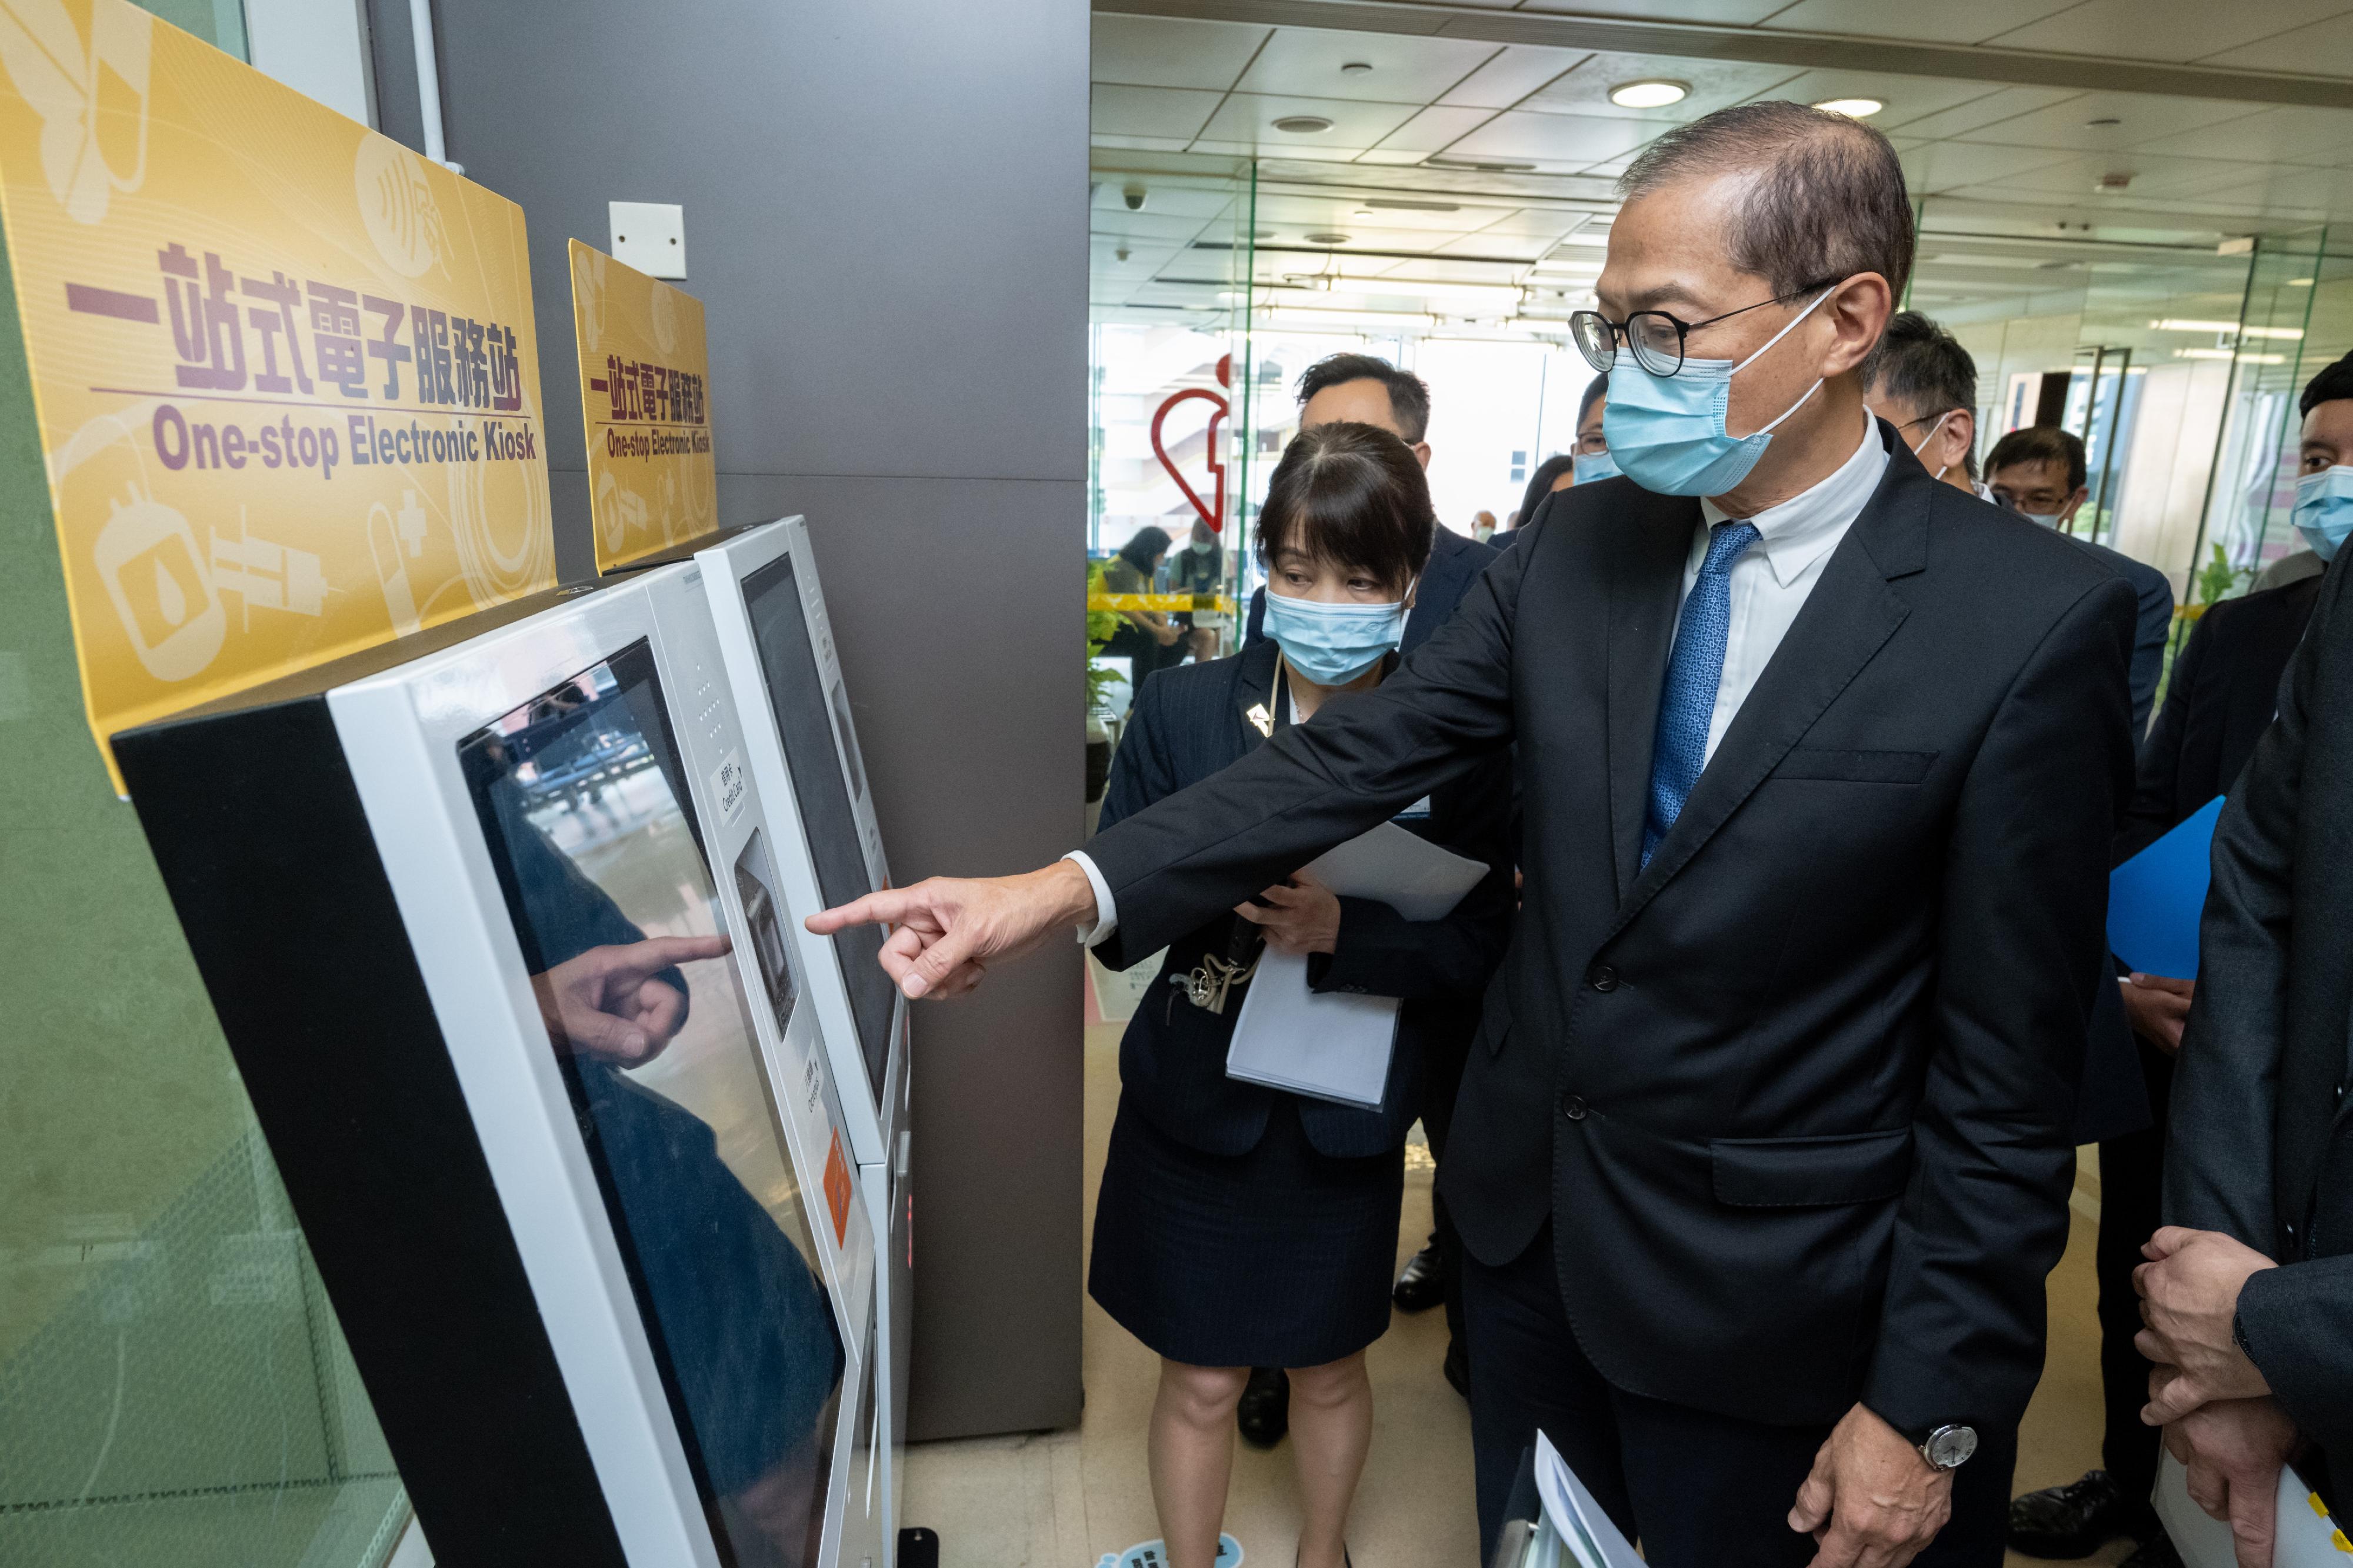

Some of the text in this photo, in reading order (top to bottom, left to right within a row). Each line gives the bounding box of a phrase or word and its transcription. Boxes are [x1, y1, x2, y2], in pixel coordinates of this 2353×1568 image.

[65, 242, 522, 412] 一站式電子服務站
[590, 354, 705, 424] 一站式電子服務站
[153, 404, 536, 480] One-stop Electronic Kiosk
[607, 428, 710, 462] One-stop Electronic Kiosk
[721, 763, 733, 787] 信用卡
[722, 776, 742, 812] Credit Card
[808, 1077, 819, 1113] Octopus
